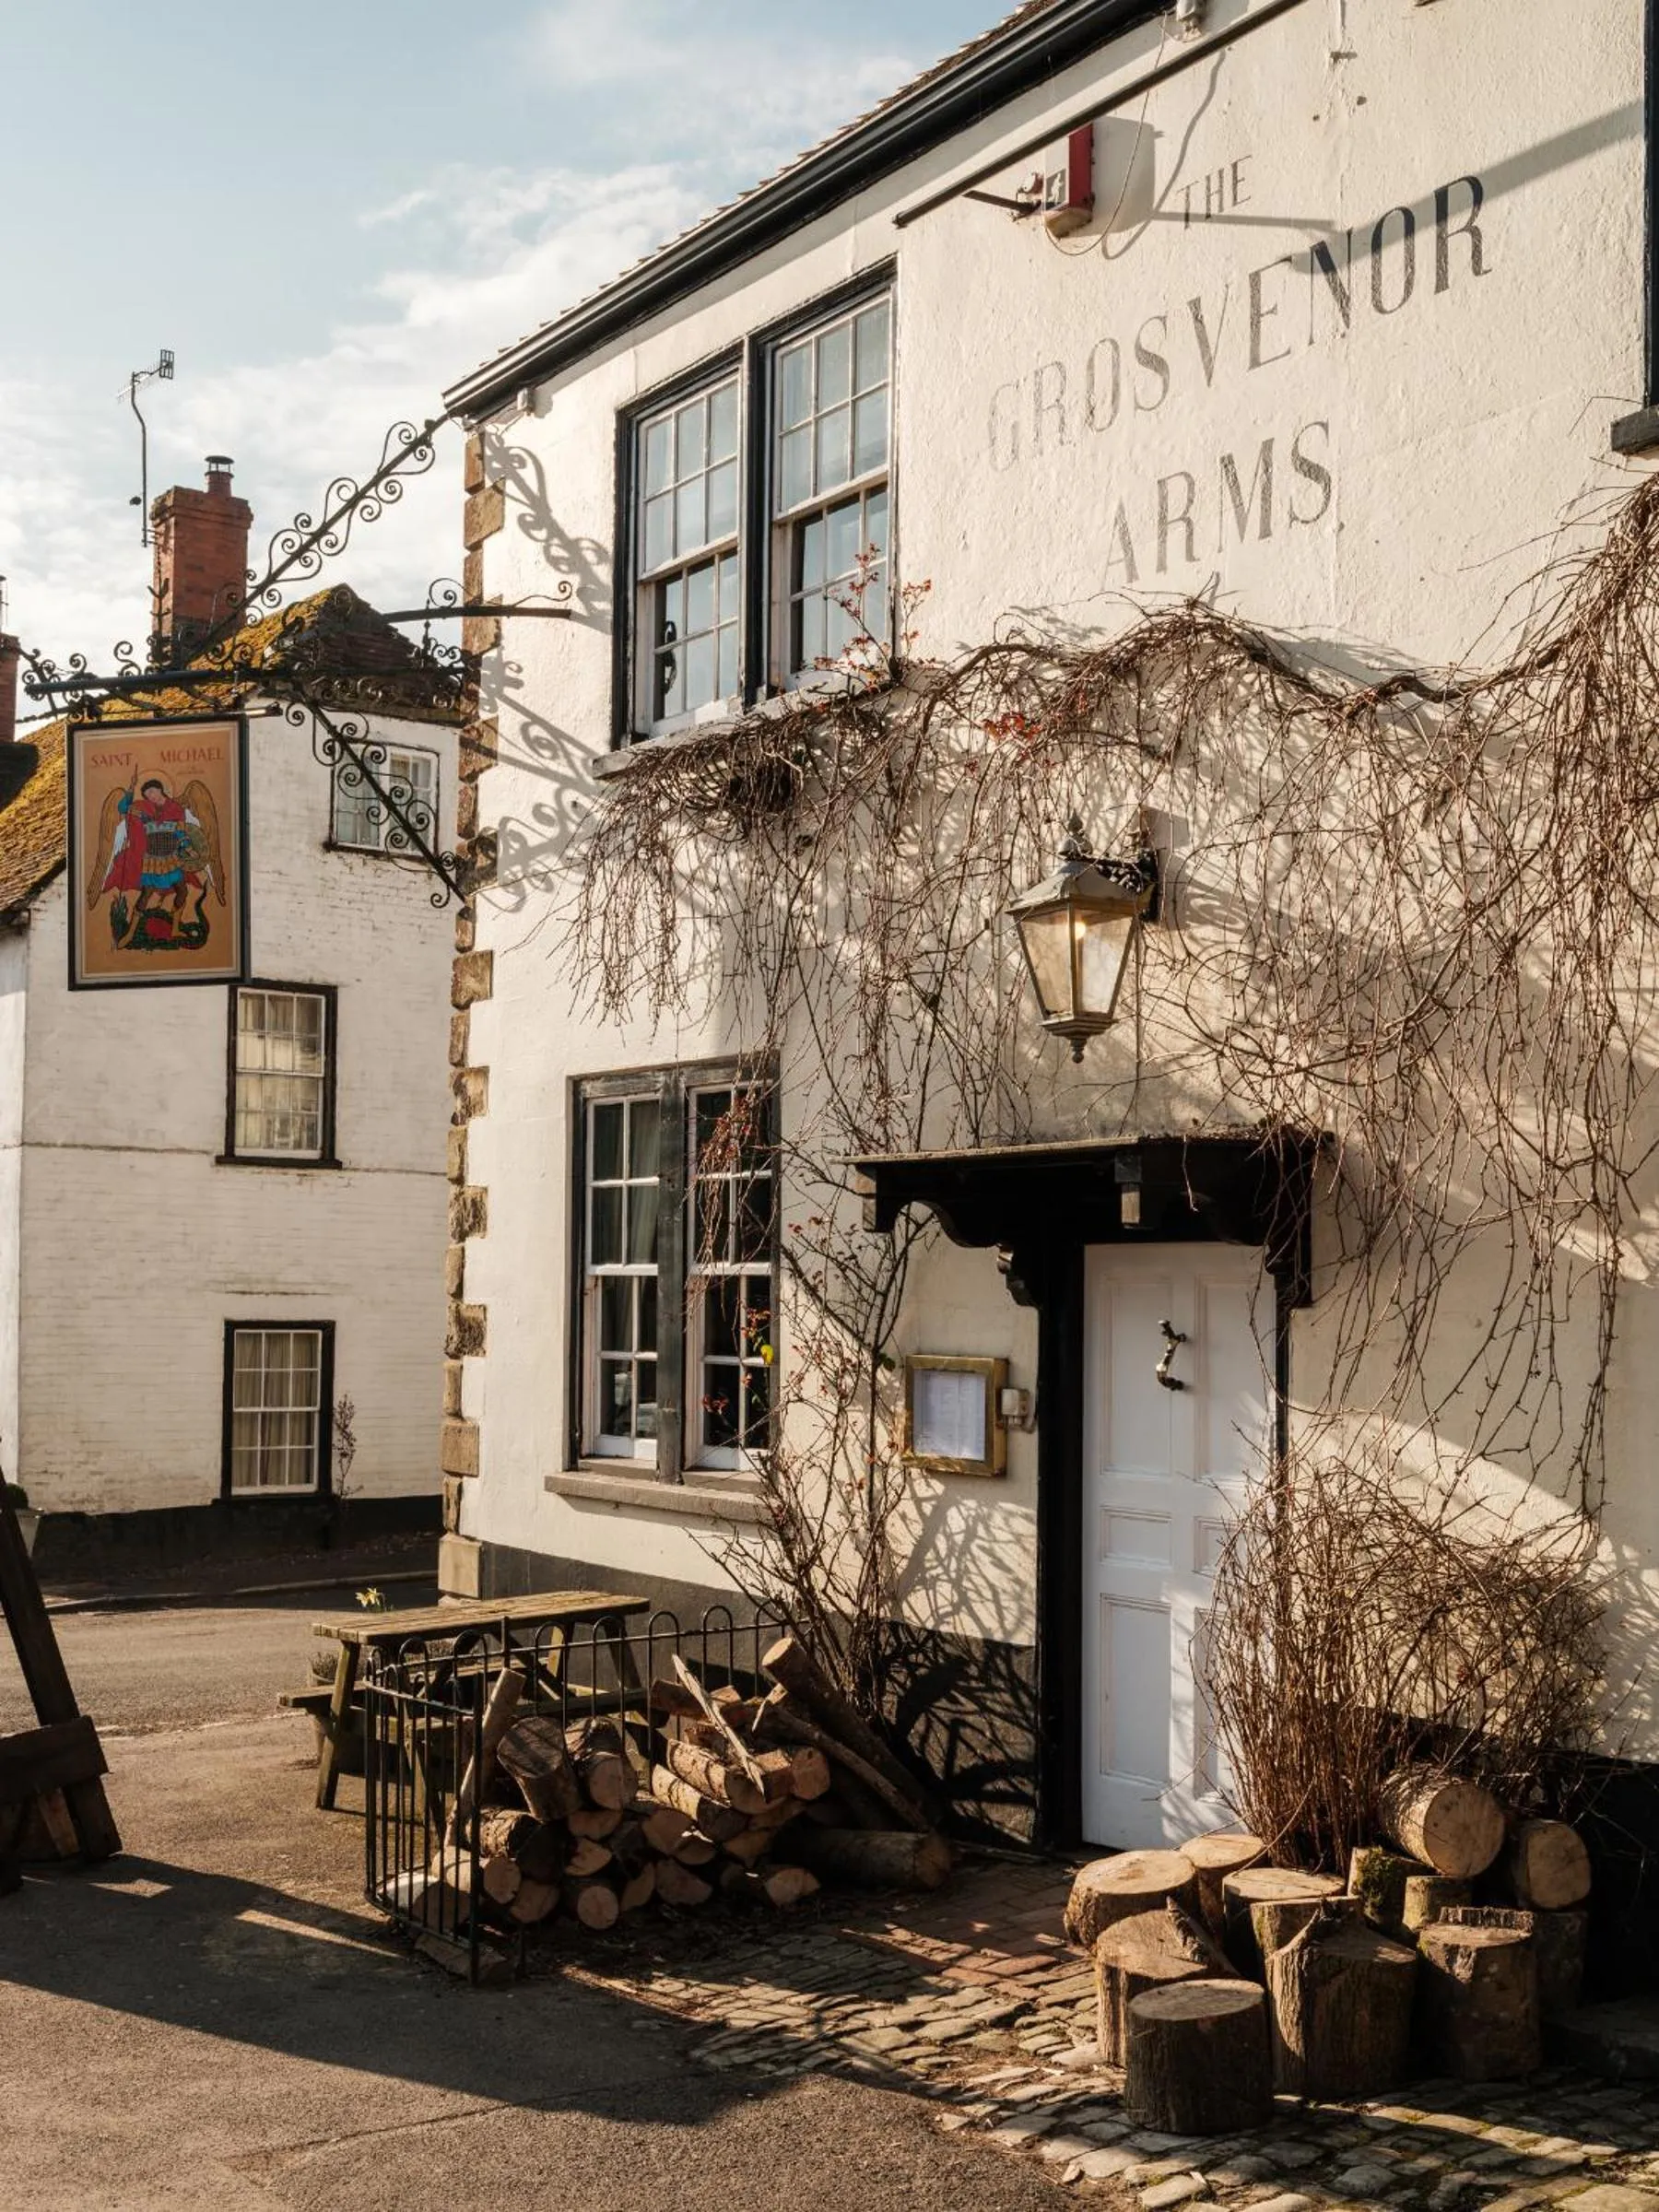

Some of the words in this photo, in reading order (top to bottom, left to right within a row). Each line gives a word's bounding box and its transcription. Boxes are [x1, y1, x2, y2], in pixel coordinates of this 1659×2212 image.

[1176, 155, 1252, 229] THE
[988, 174, 1492, 471] GROSVENOR
[1100, 418, 1331, 591] ARMS
[91, 752, 133, 768] SAINT
[159, 747, 224, 763] MICHAEL
